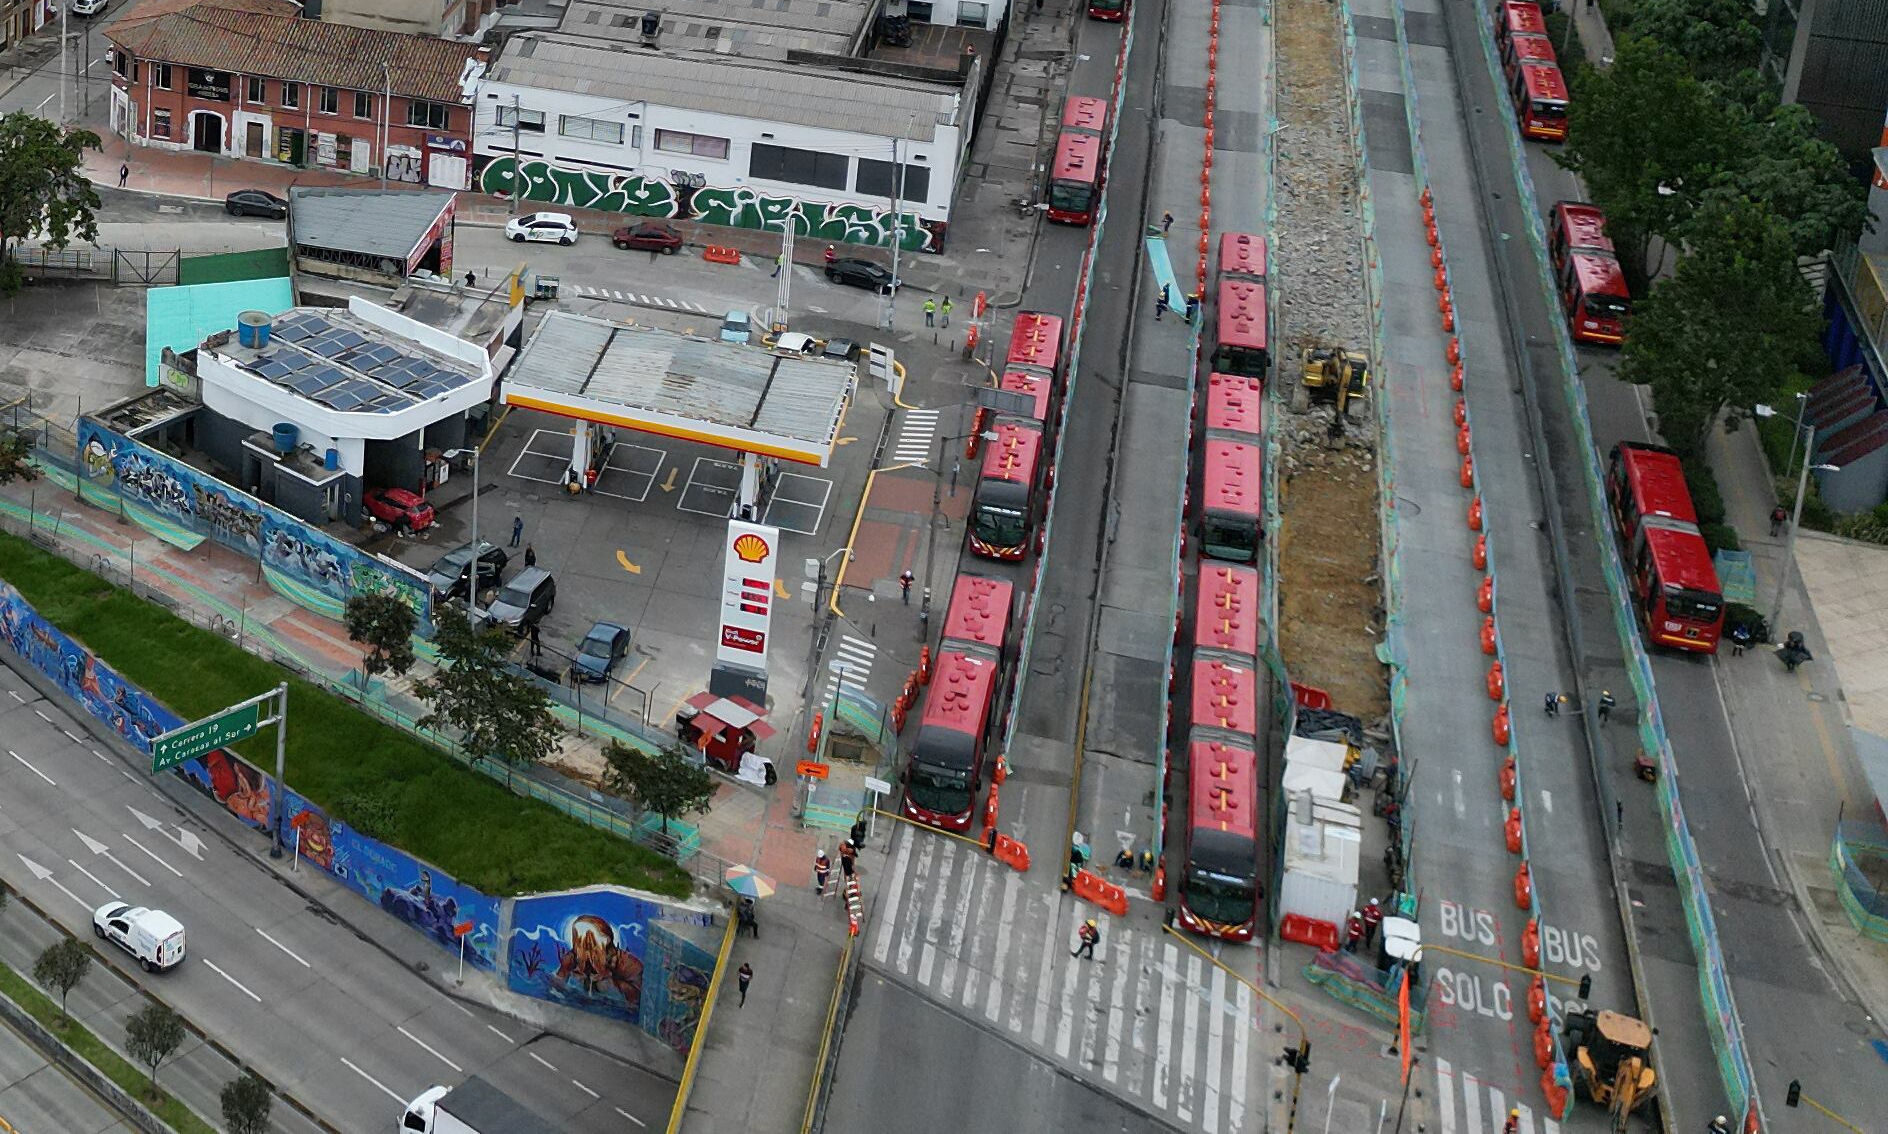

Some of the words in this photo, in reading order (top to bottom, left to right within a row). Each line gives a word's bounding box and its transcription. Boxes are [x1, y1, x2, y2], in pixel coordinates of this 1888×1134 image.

[159, 757, 171, 767] Av
[174, 741, 210, 761] Caracas
[213, 736, 222, 746] al
[224, 729, 240, 741] Sur
[171, 731, 205, 749] Carrera
[208, 723, 219, 735] 19
[1440, 900, 1495, 946] BUS
[1544, 925, 1602, 972] BUS
